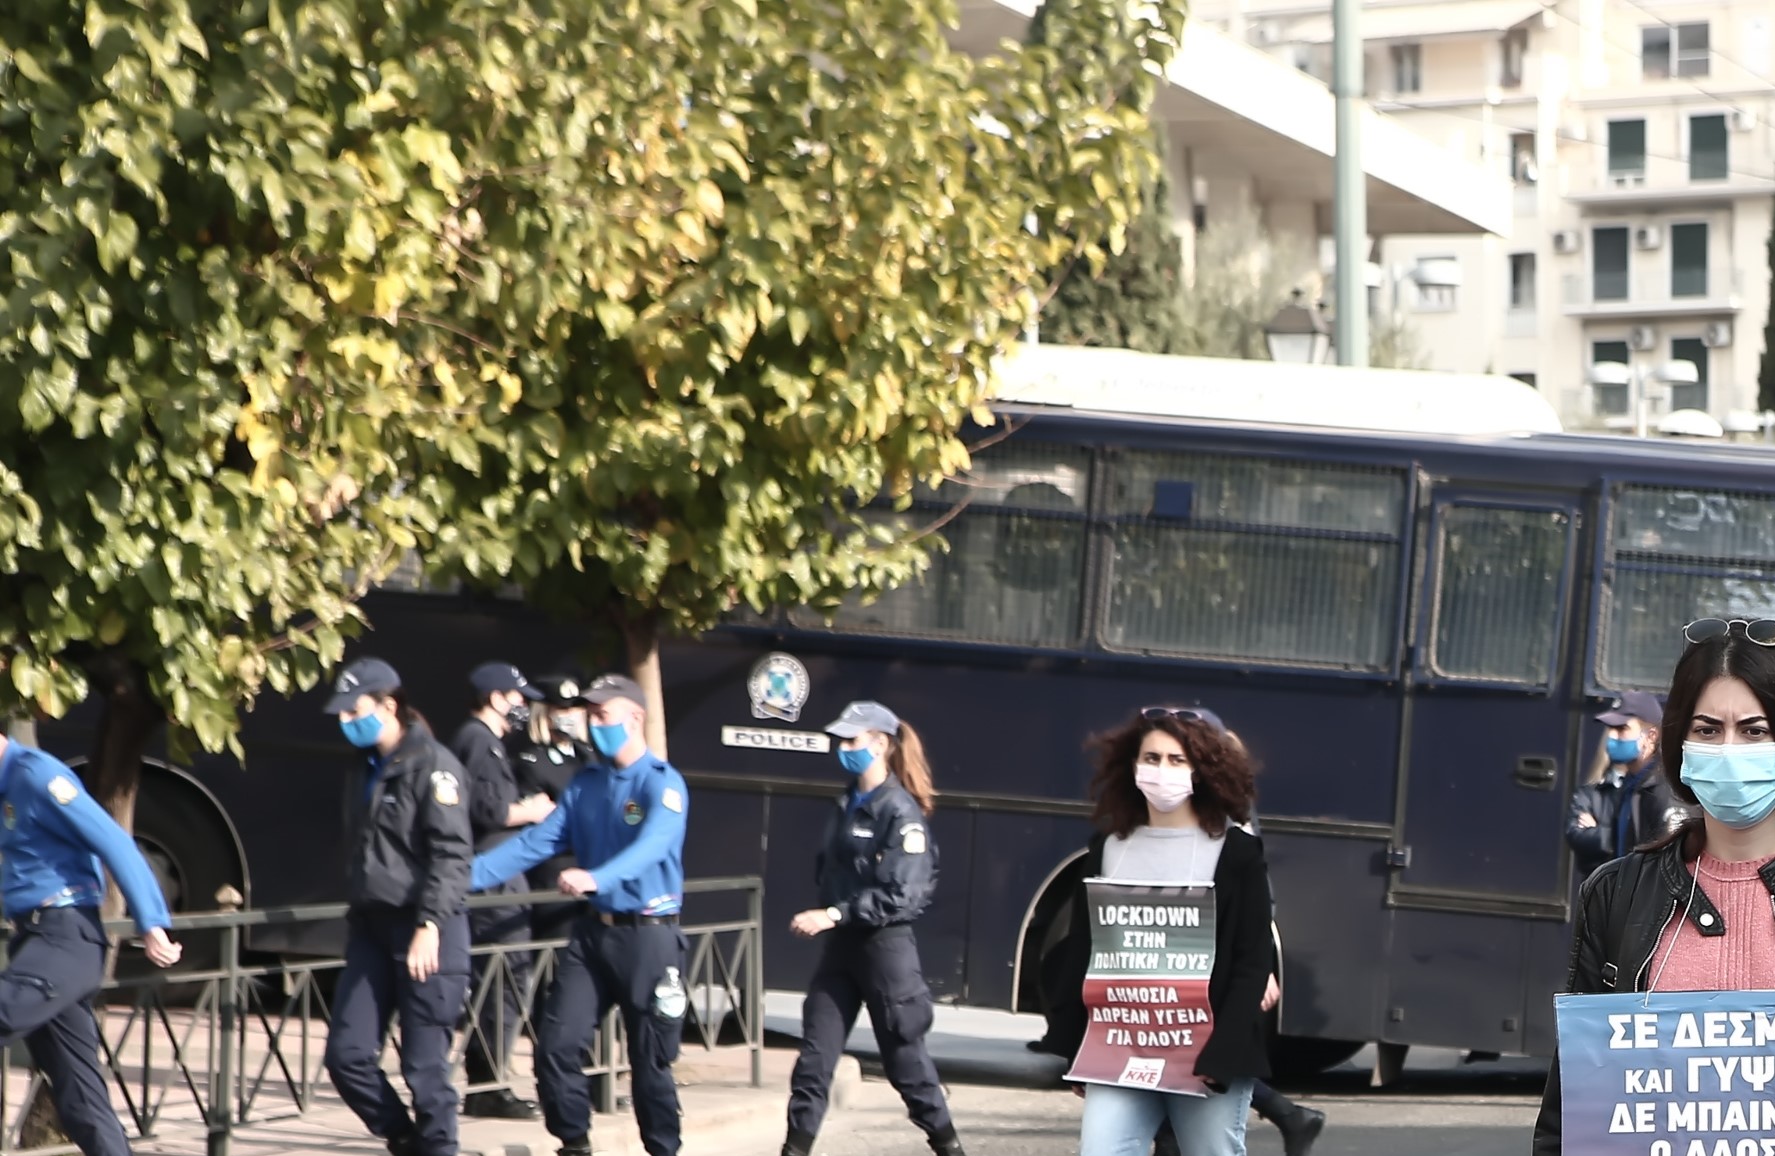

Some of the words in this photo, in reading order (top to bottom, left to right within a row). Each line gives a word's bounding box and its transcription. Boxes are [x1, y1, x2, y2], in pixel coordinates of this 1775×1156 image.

[735, 732, 818, 749] POLICE
[1098, 906, 1199, 927] LOCKDOWN
[1123, 931, 1166, 948] ΣΤΗΝ
[1095, 953, 1158, 970] ΠΟΛΙΤΙΚΗ
[1166, 954, 1209, 970] ΤΟΥΣ
[1106, 987, 1178, 1003] ΔΗΜΟΣΙΑ
[1093, 1007, 1150, 1024] ΔΩΡΕΑΝ
[1154, 1008, 1208, 1025] ΥΓΕΙΑ
[1106, 1029, 1133, 1046] ΓΙΑ
[1137, 1030, 1193, 1047] ΟΛΟΥΣ
[1608, 1013, 1659, 1050] ΣΕ
[1125, 1071, 1157, 1083] ΚΚΕ
[1625, 1069, 1672, 1094] ΚΑΙ
[1609, 1101, 1656, 1133] ΔΕ
